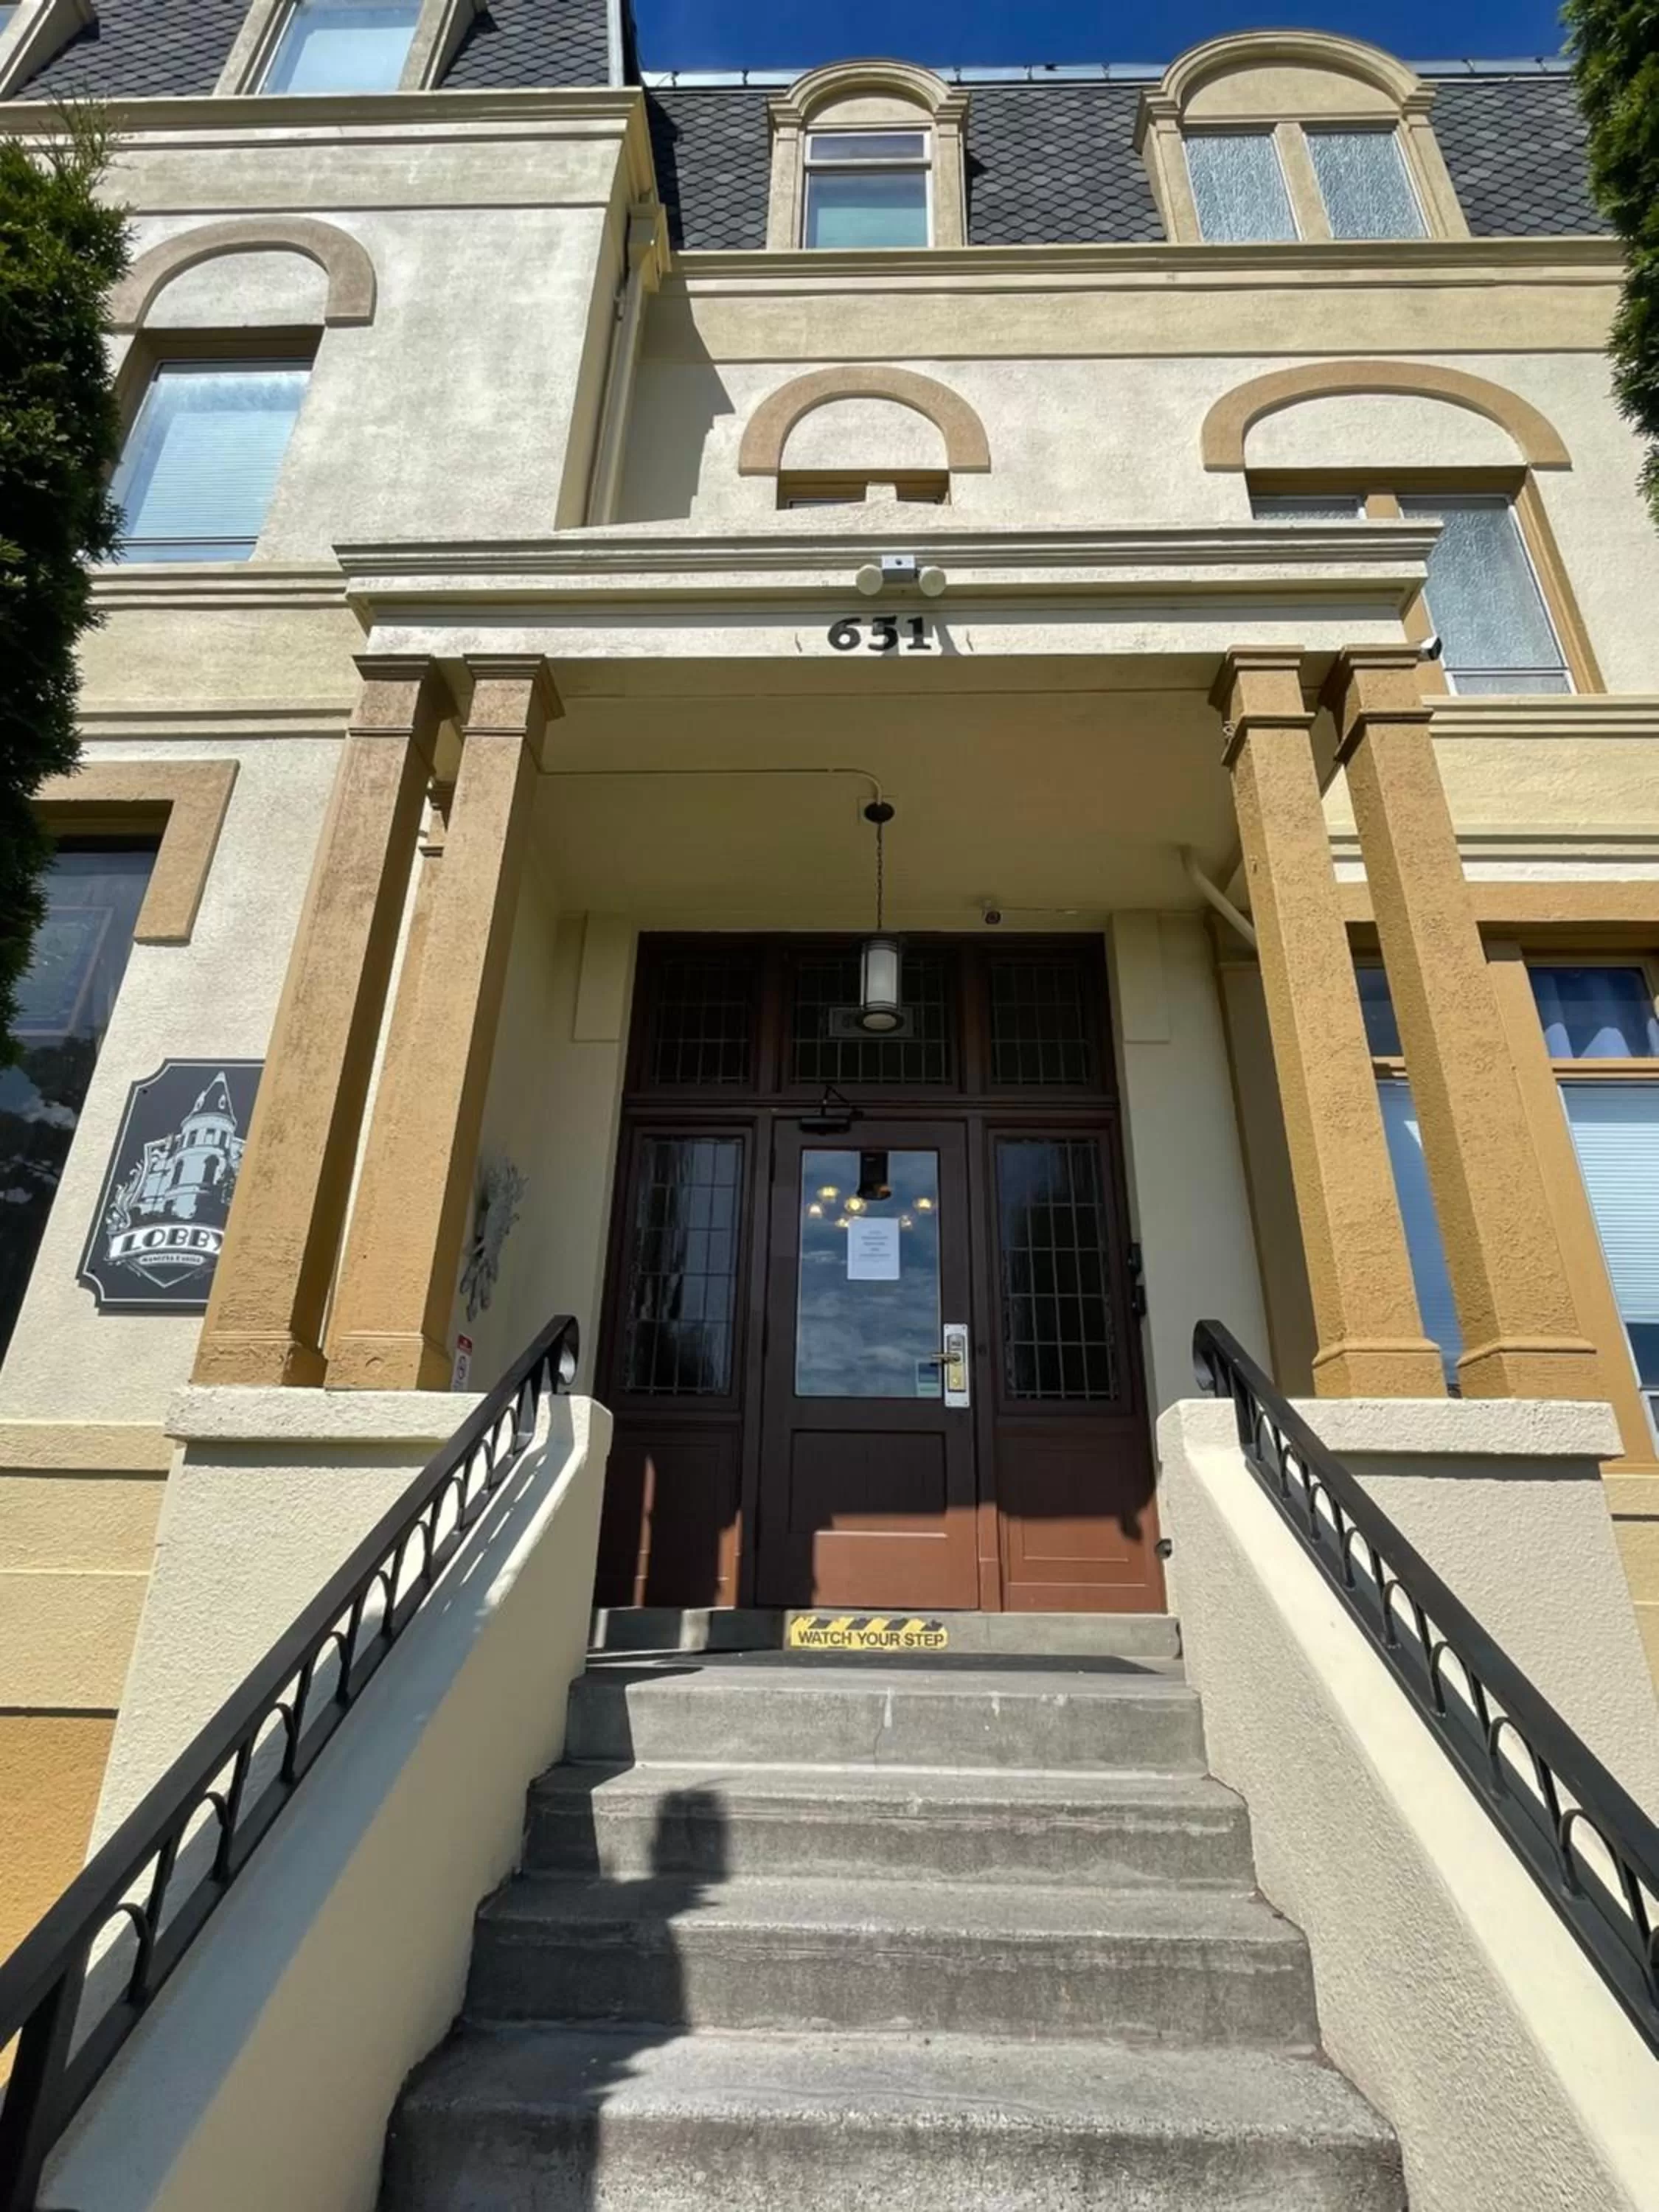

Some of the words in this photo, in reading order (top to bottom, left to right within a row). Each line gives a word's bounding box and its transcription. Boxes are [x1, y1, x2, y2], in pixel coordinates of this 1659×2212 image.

[827, 615, 931, 651] 651
[798, 1631, 852, 1645] WATCH
[858, 1632, 900, 1646] YOUR
[905, 1632, 944, 1646] STEP
